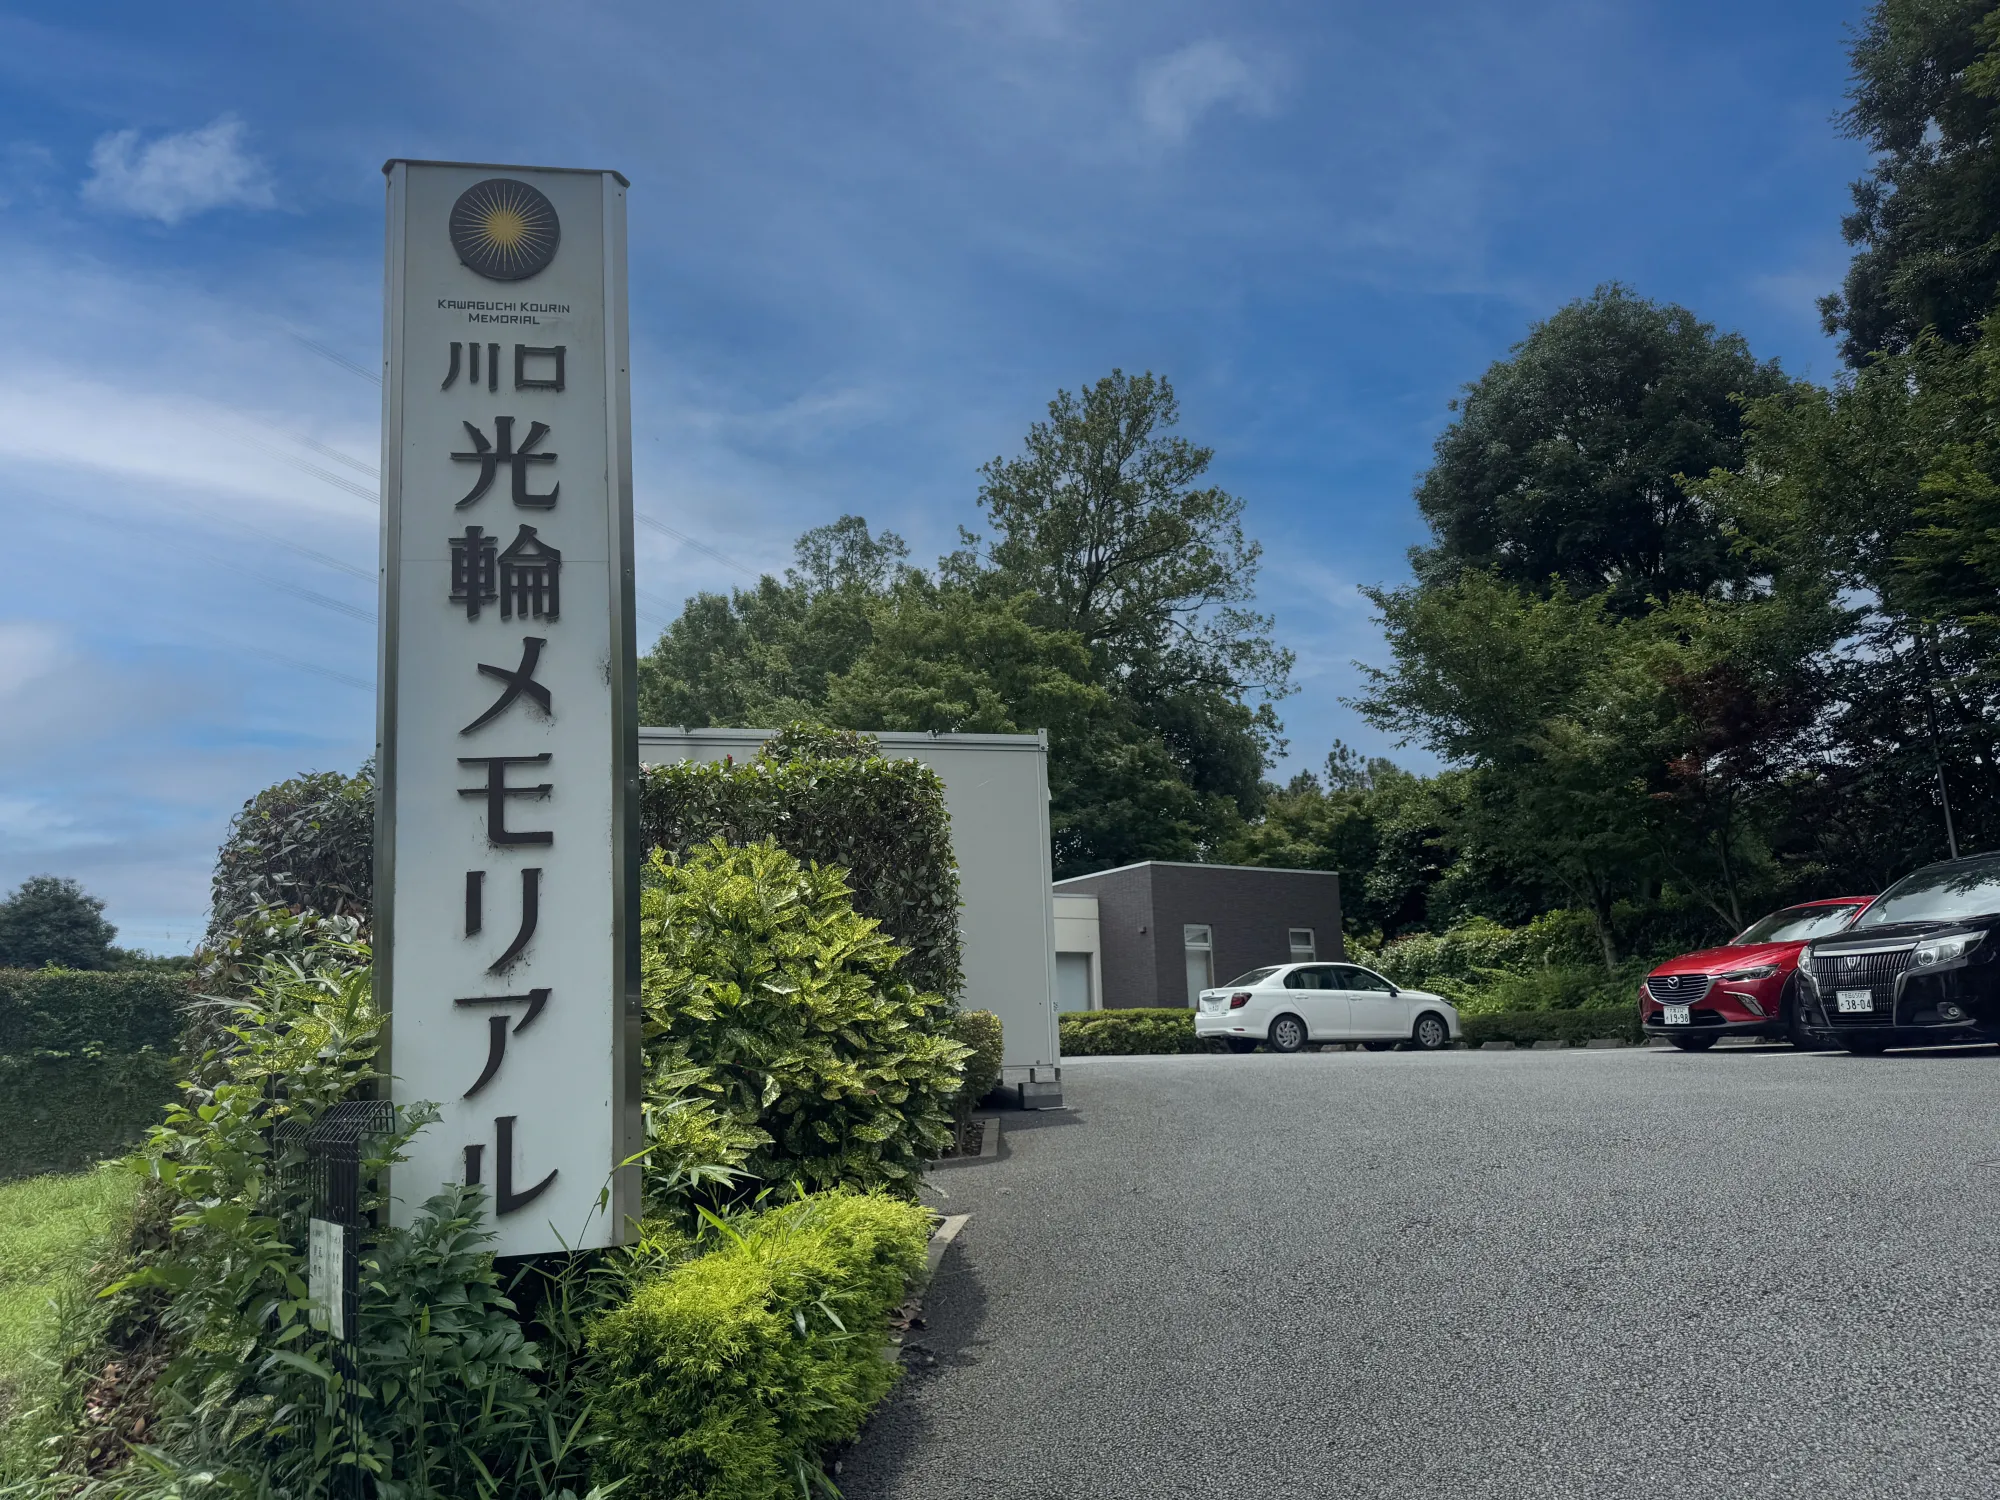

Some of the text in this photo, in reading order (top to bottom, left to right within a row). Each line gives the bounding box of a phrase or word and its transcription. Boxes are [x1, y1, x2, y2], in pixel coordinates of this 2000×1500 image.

[437, 299, 570, 313] KAWAGUCHI KOURIN
[468, 313, 540, 325] MEMORIAL
